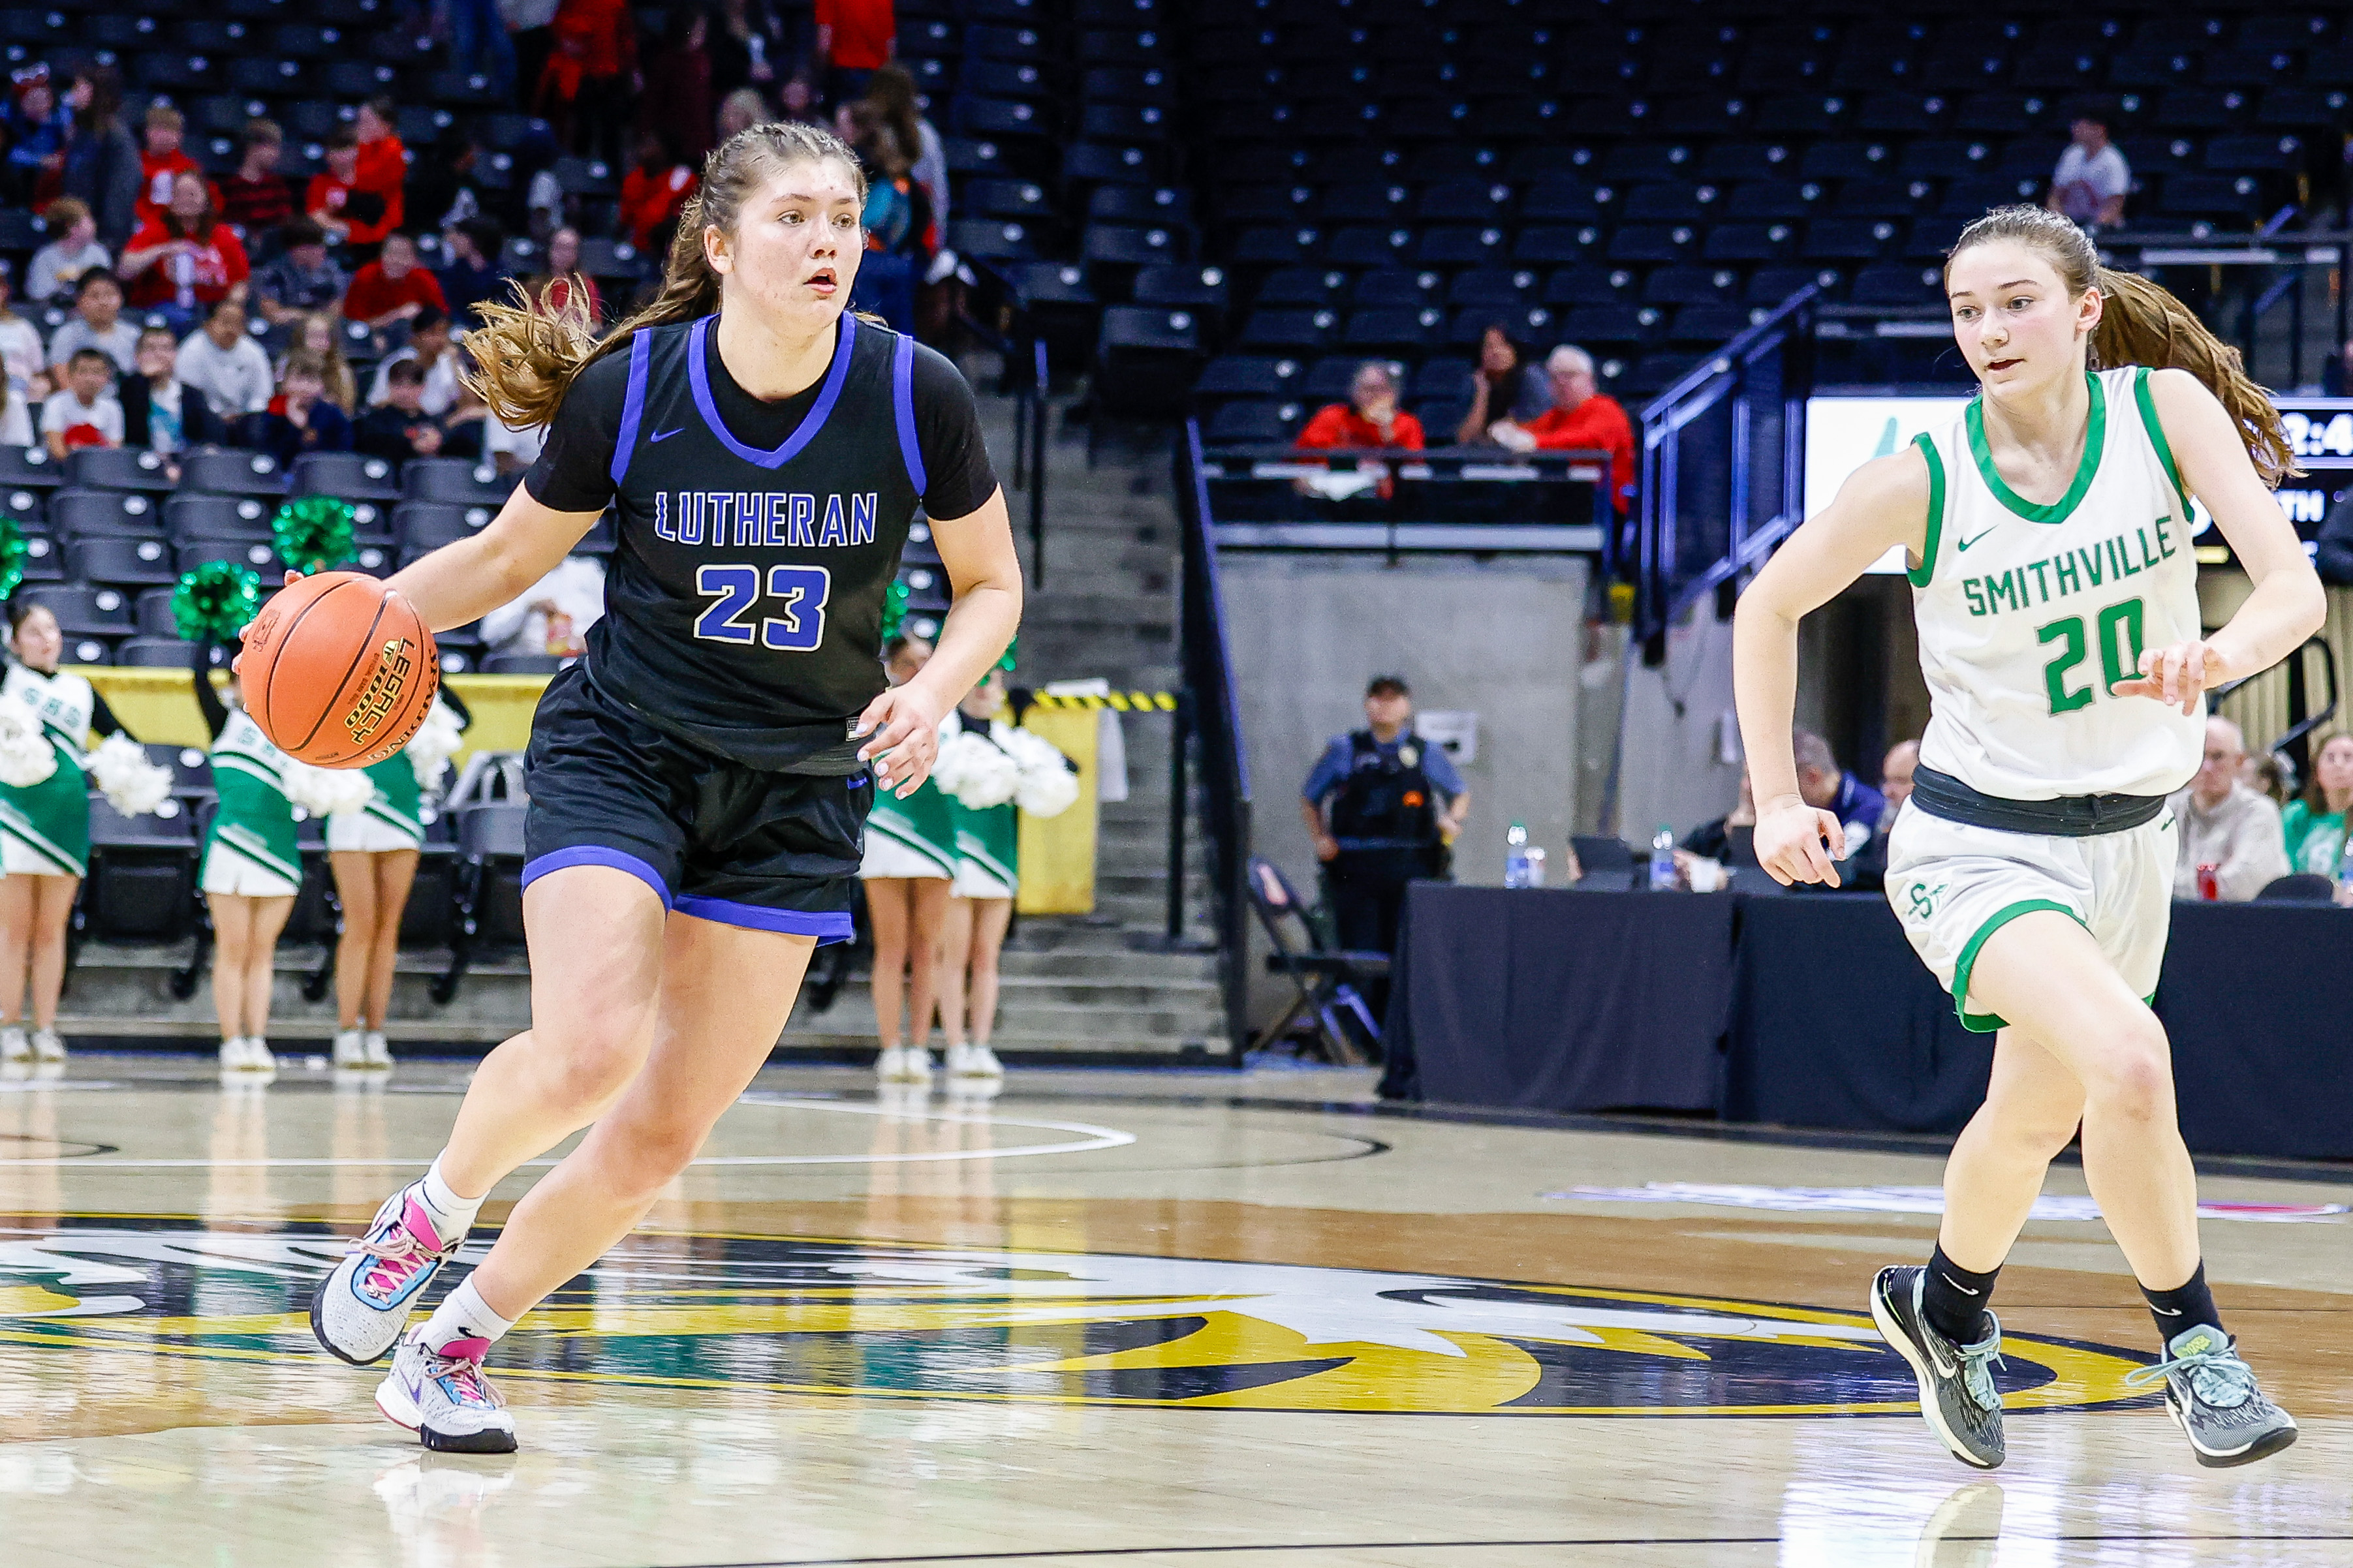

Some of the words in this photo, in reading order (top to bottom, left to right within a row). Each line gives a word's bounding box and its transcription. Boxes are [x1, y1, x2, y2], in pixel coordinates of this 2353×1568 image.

[655, 491, 879, 547] LUTHERAN
[1961, 515, 2177, 616] SMITHVILLE
[693, 564, 831, 652] 23
[2034, 596, 2146, 718] 20
[351, 636, 416, 745] LEGACY
